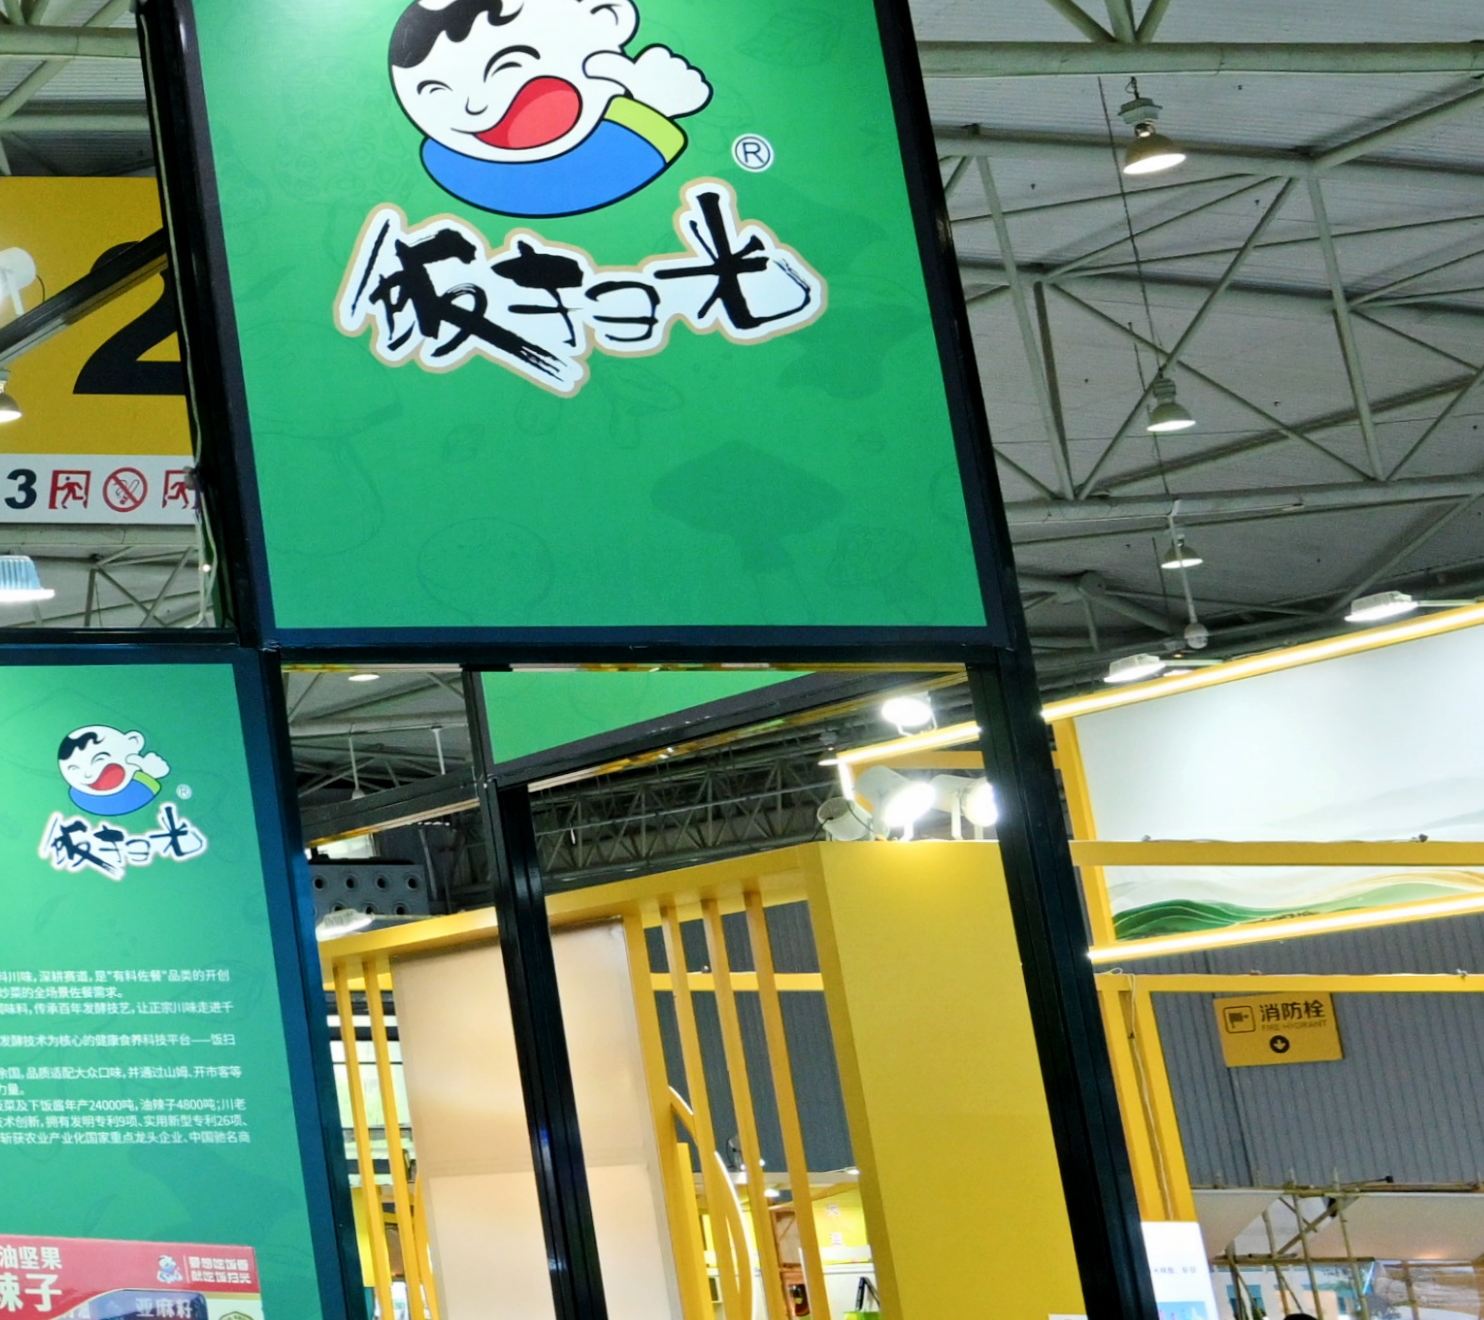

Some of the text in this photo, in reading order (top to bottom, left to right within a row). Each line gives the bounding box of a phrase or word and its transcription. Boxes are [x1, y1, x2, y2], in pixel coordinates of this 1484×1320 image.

[351, 192, 813, 383] 饭扫光
[4, 468, 37, 509] 3
[46, 804, 202, 875] 饭扫光
[1259, 999, 1326, 1022] 消防栓
